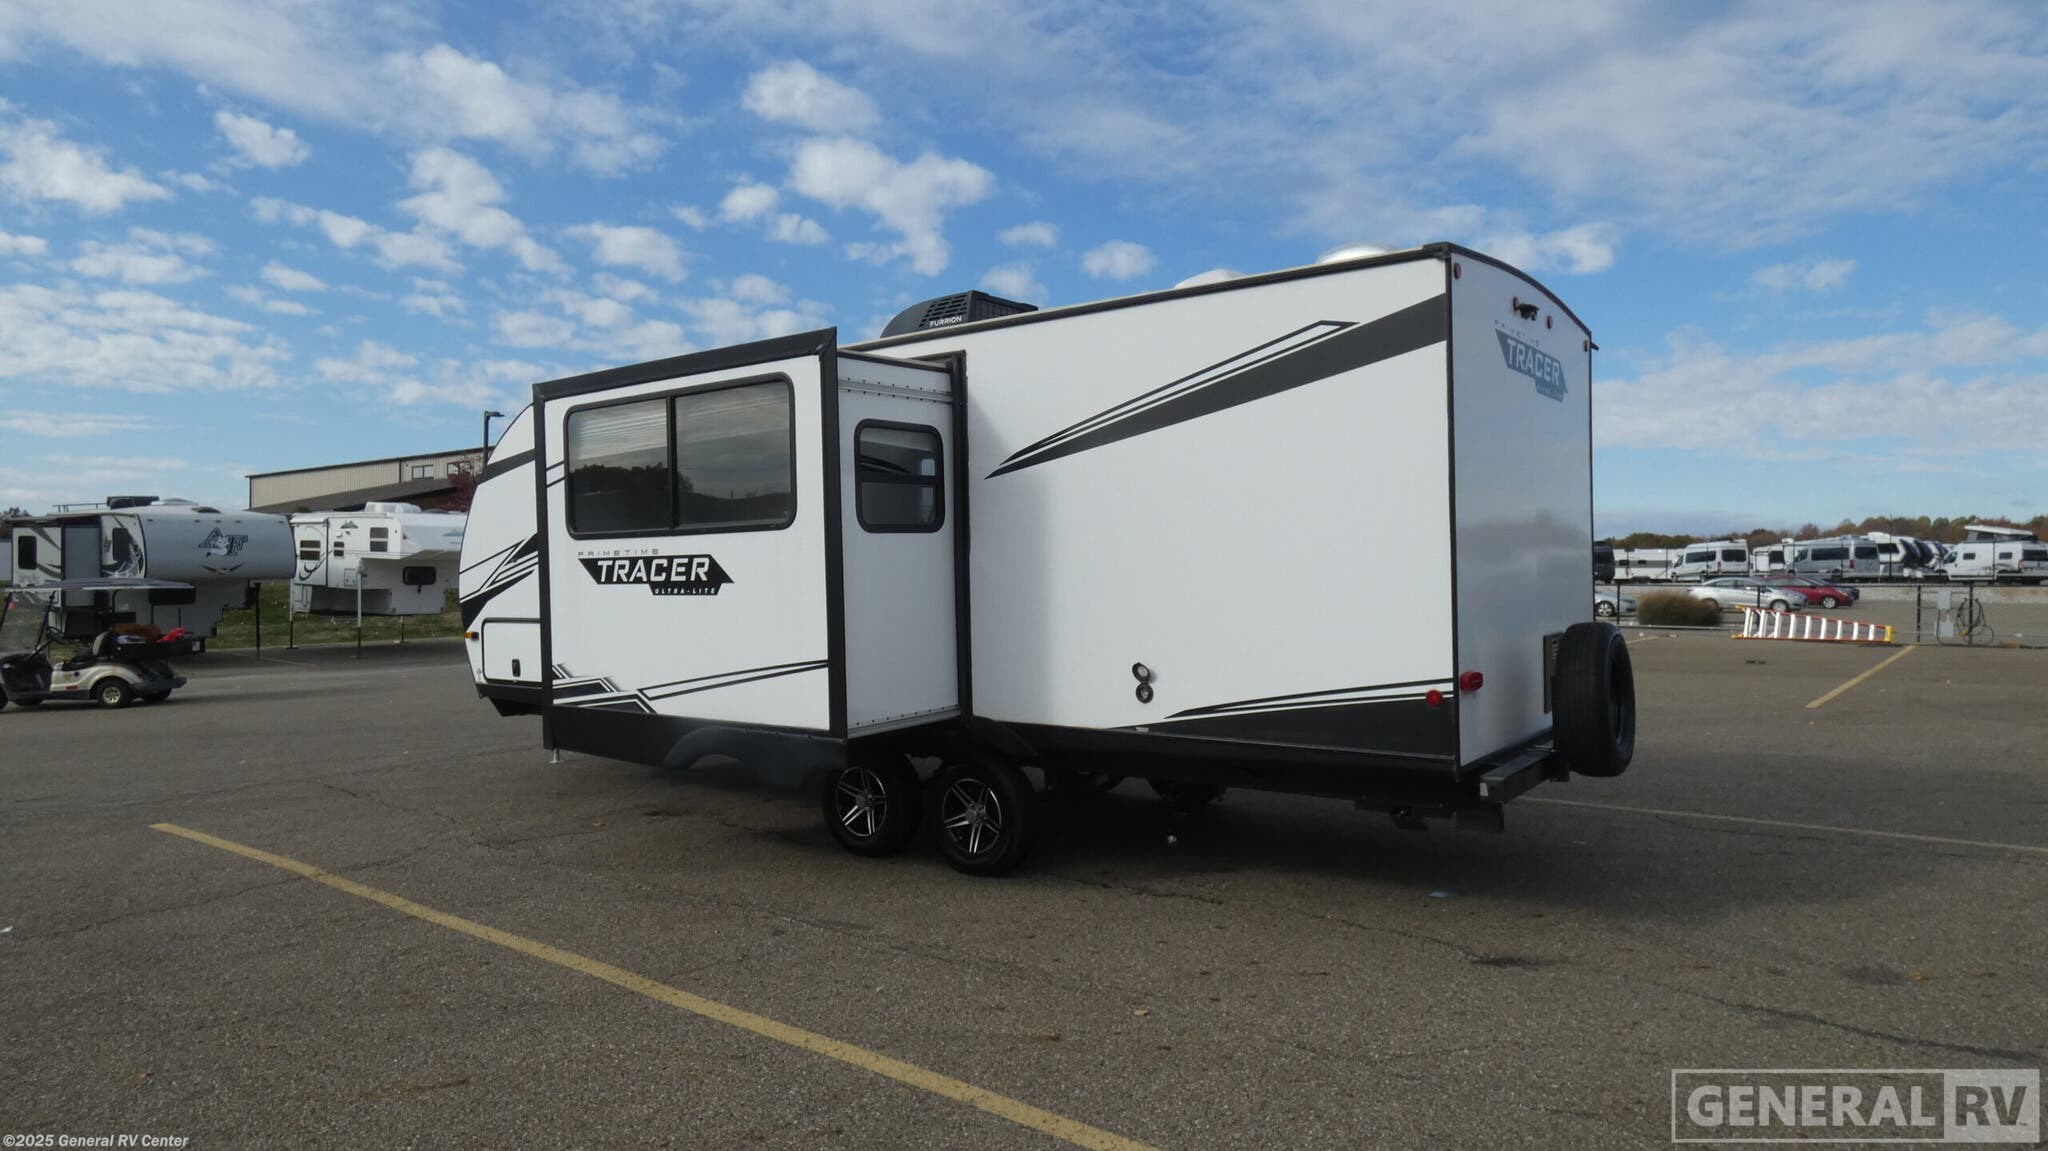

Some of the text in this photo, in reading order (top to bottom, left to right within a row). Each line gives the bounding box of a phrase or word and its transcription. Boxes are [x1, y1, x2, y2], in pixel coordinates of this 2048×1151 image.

[929, 315, 962, 327] FURRION
[1506, 337, 1560, 387] TRACER
[577, 548, 660, 557] PRIMETIME
[597, 557, 710, 583] TRACER
[654, 587, 716, 595] ULTRA-LITE
